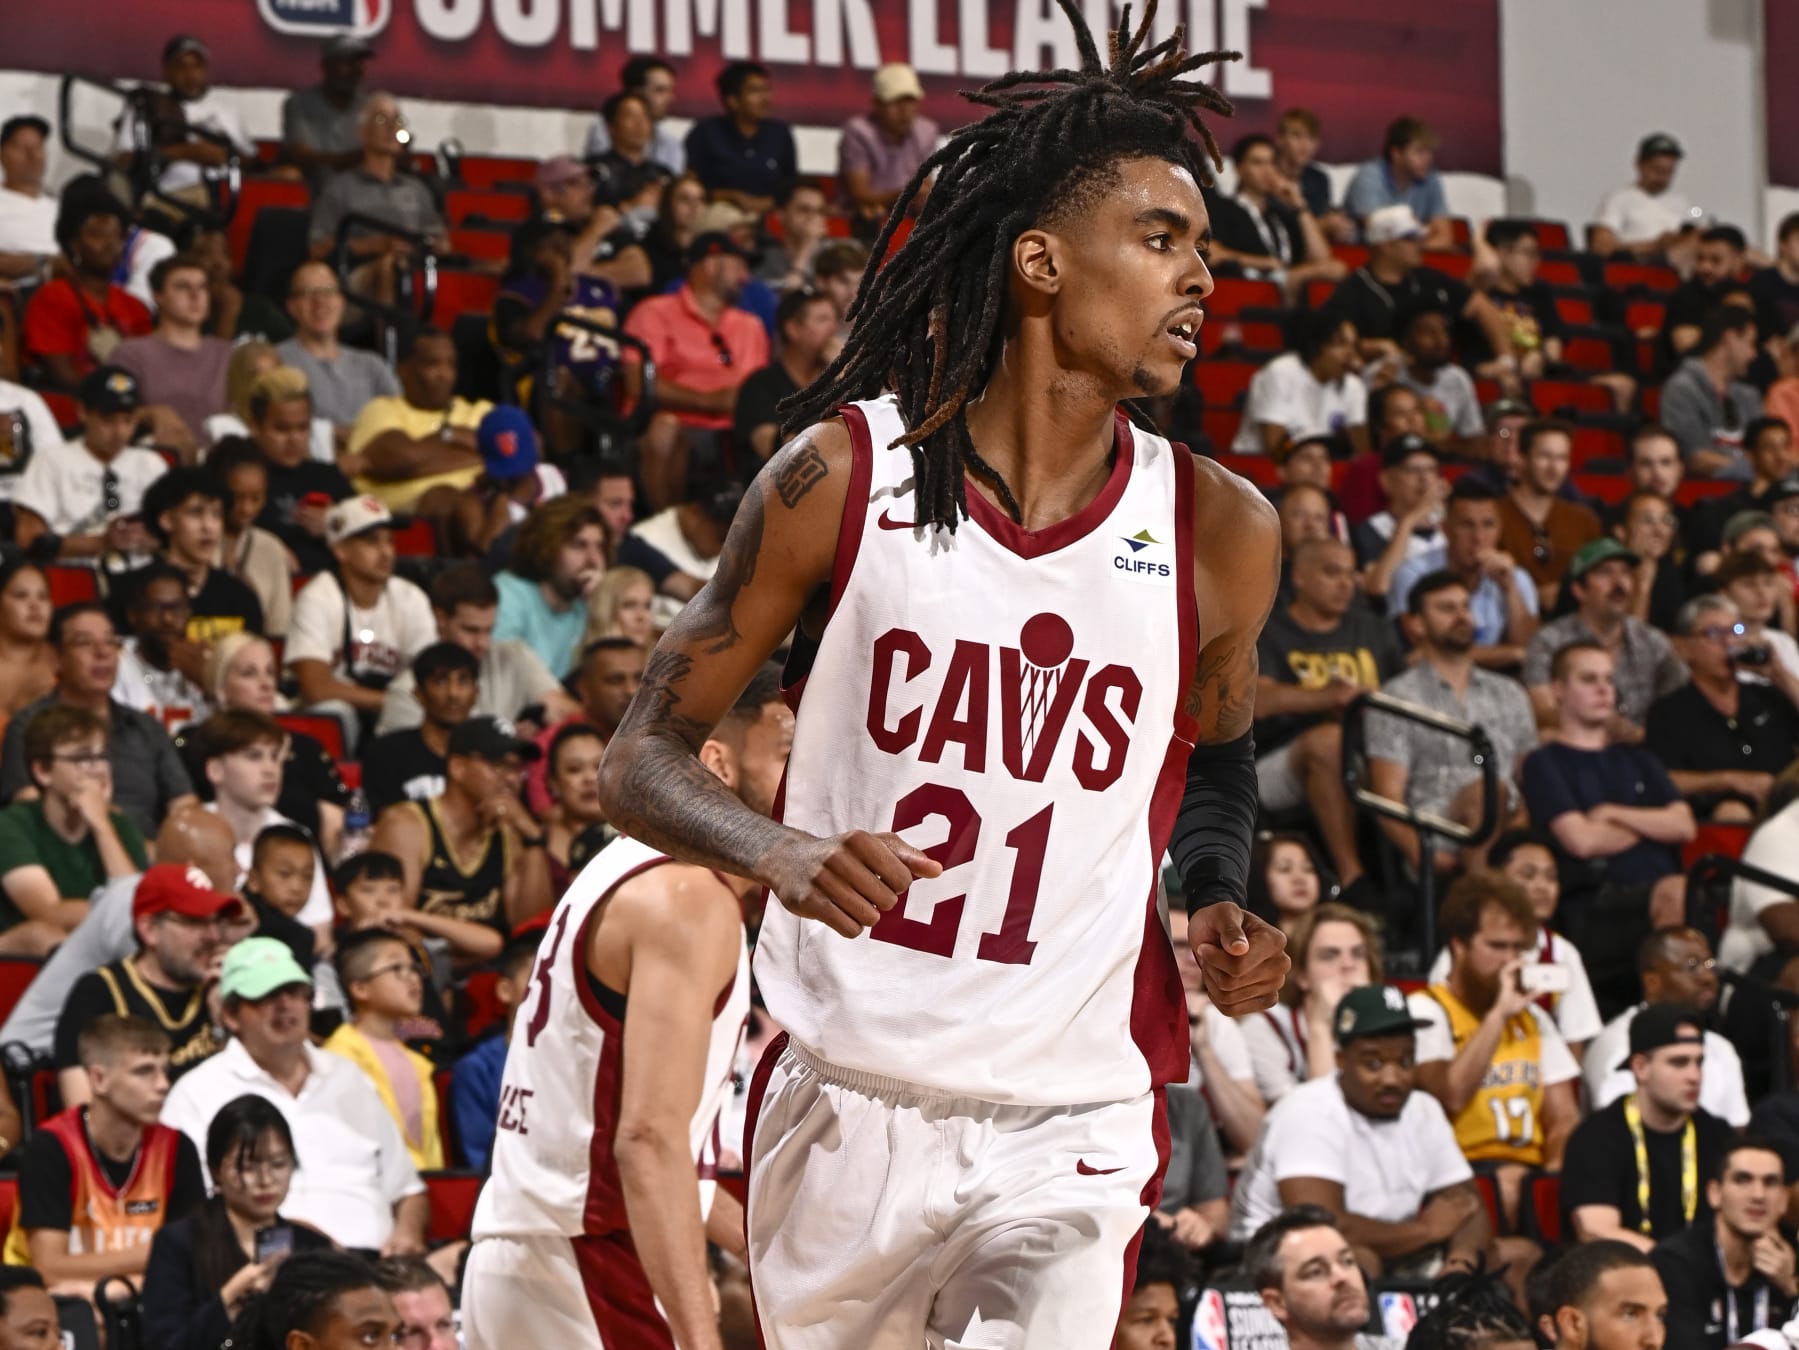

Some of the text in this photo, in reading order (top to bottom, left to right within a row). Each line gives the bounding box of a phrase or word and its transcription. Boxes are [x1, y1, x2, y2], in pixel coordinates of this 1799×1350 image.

[1114, 555, 1171, 577] CLIFFS
[867, 627, 1143, 792] CAVS
[869, 782, 1054, 965] 21
[1489, 1097, 1534, 1141] 17
